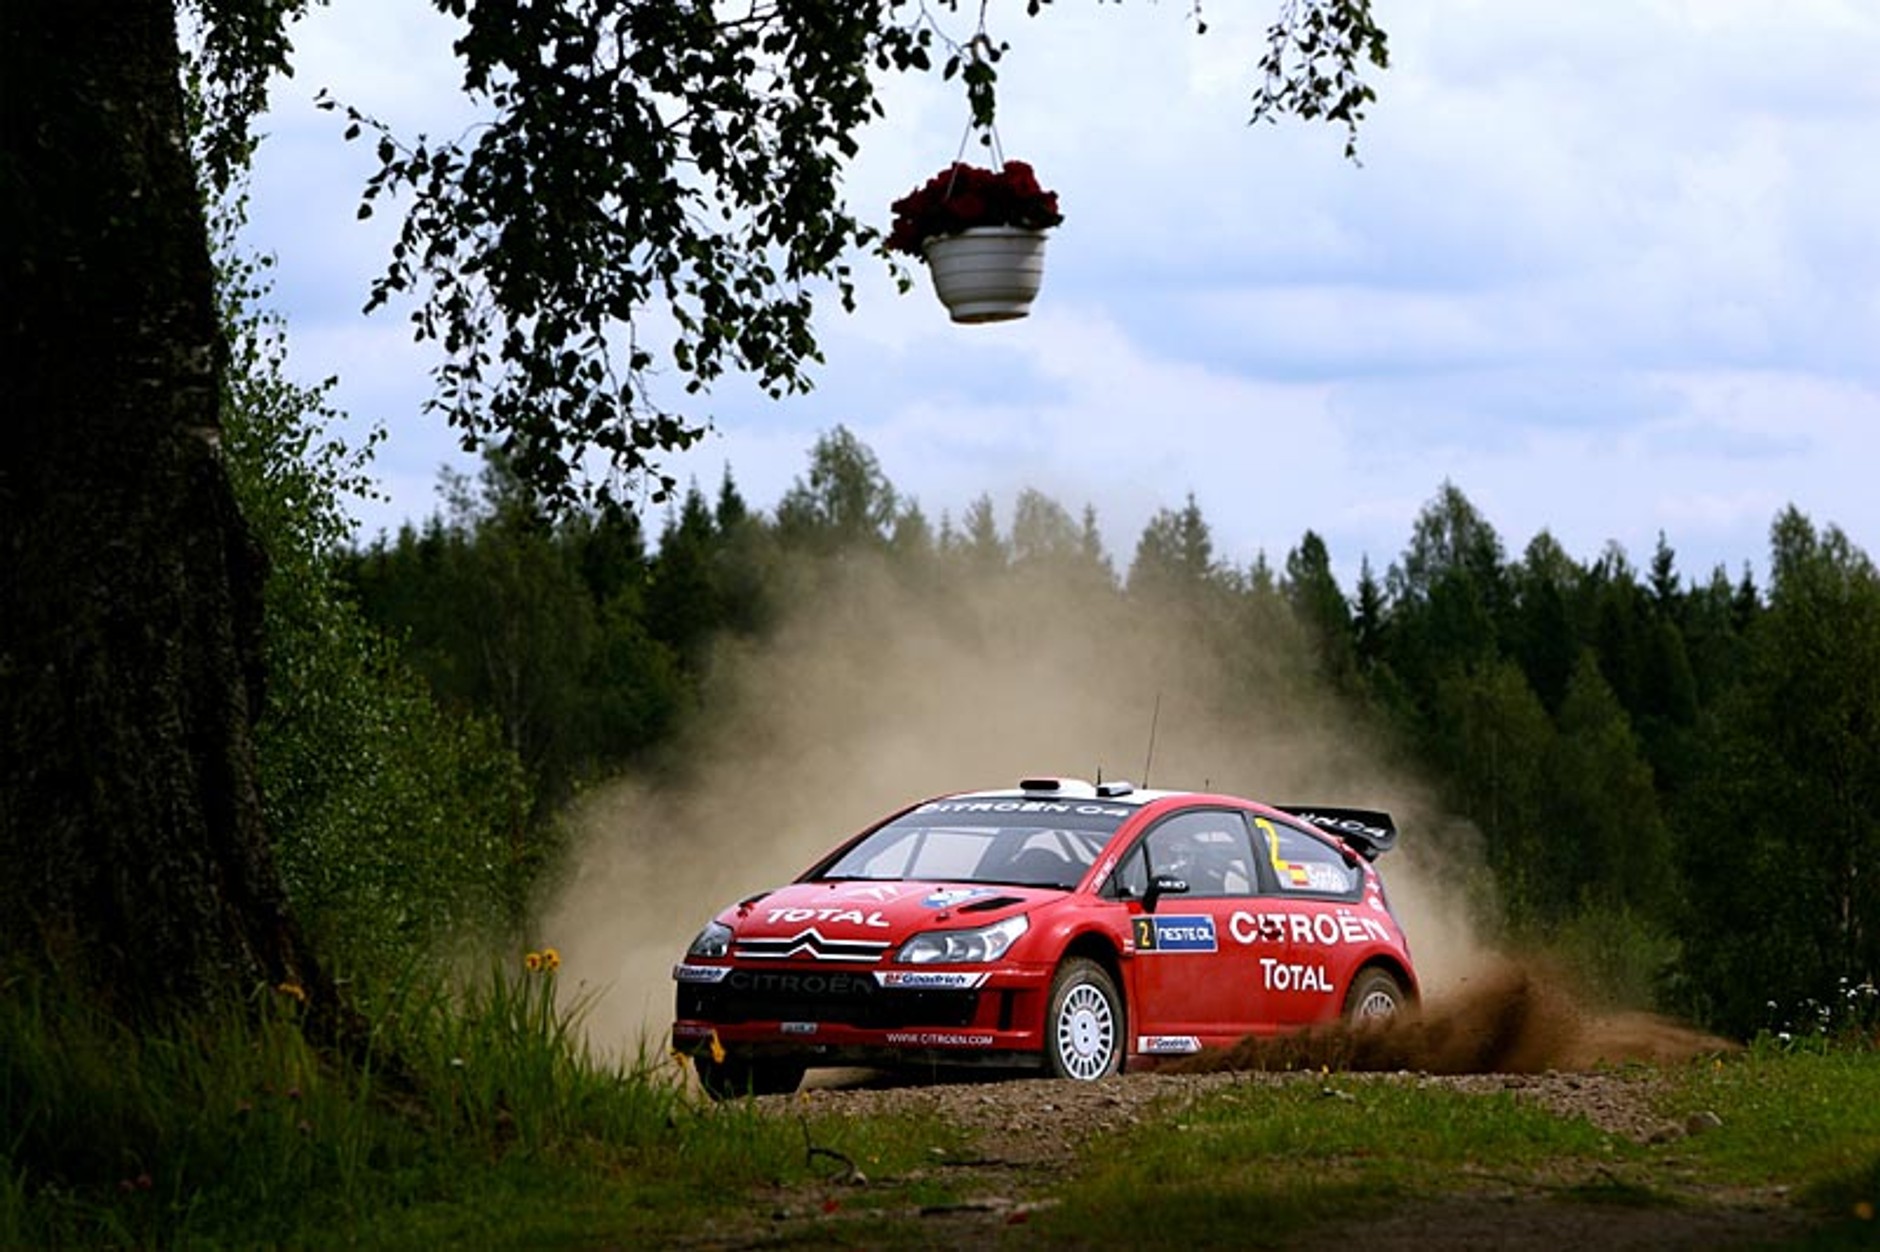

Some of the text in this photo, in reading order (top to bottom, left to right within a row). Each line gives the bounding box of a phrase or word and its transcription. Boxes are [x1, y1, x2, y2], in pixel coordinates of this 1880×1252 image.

[1254, 817, 1288, 871] 2
[767, 908, 890, 927] TOTAL
[1140, 921, 1151, 947] 2
[730, 971, 873, 994] CITROËN
